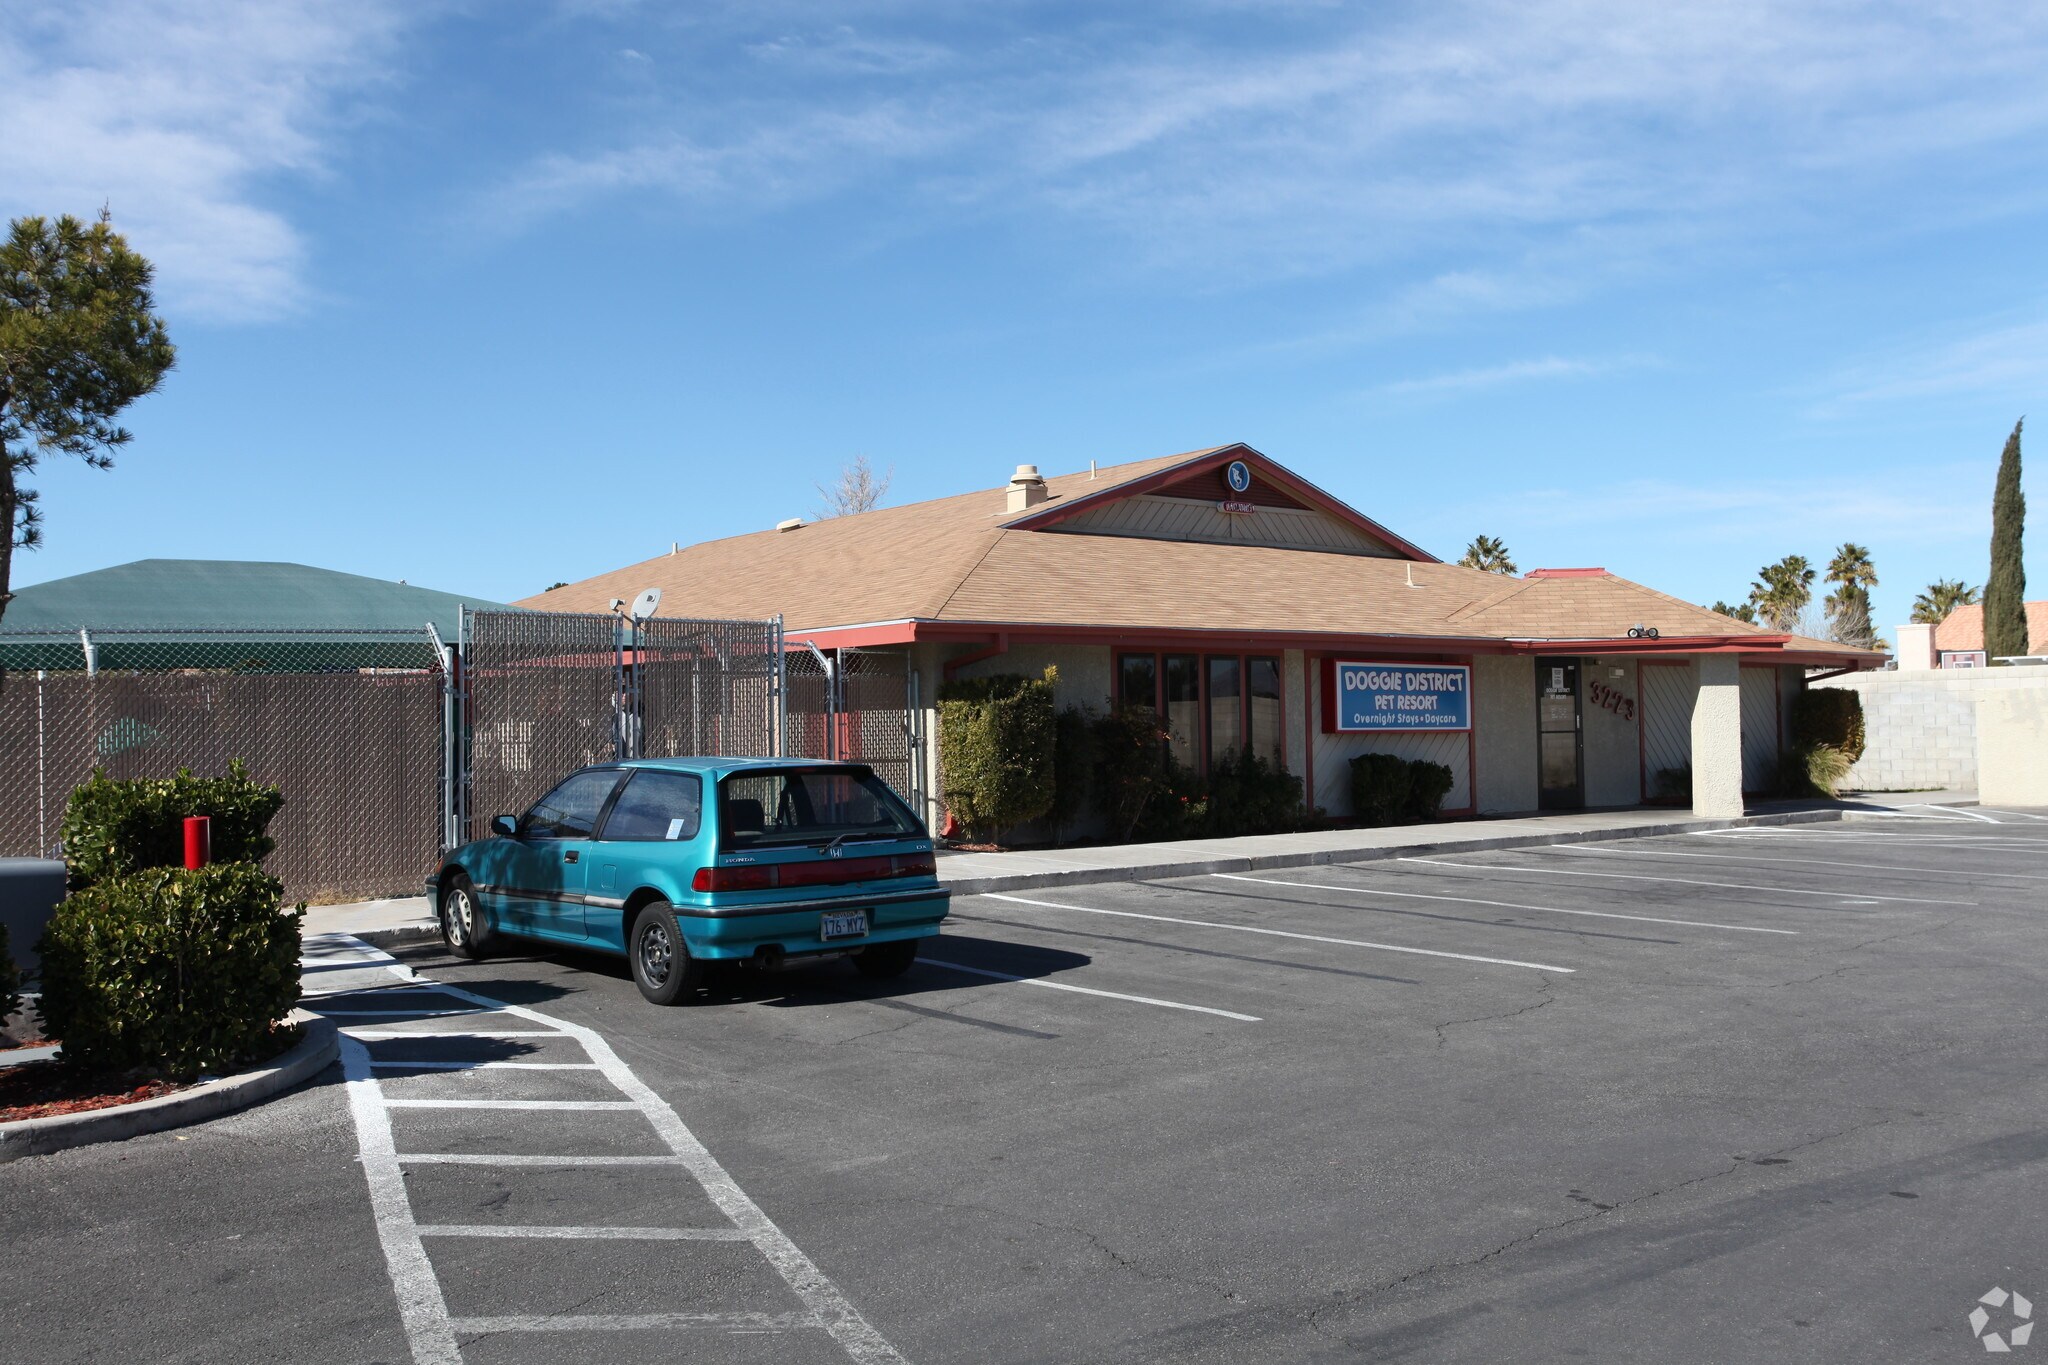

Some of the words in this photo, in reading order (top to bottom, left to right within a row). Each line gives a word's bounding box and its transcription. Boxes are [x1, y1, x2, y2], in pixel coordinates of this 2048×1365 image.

[1344, 671, 1402, 691] DOGGIE
[1405, 672, 1463, 692] DISTRICT
[1375, 694, 1394, 710] PET
[1397, 695, 1438, 710] RESORT
[1590, 680, 1634, 720] 3223
[1353, 712, 1396, 726] Overnight
[1397, 713, 1419, 726] Stays
[1424, 713, 1457, 726] Daycare
